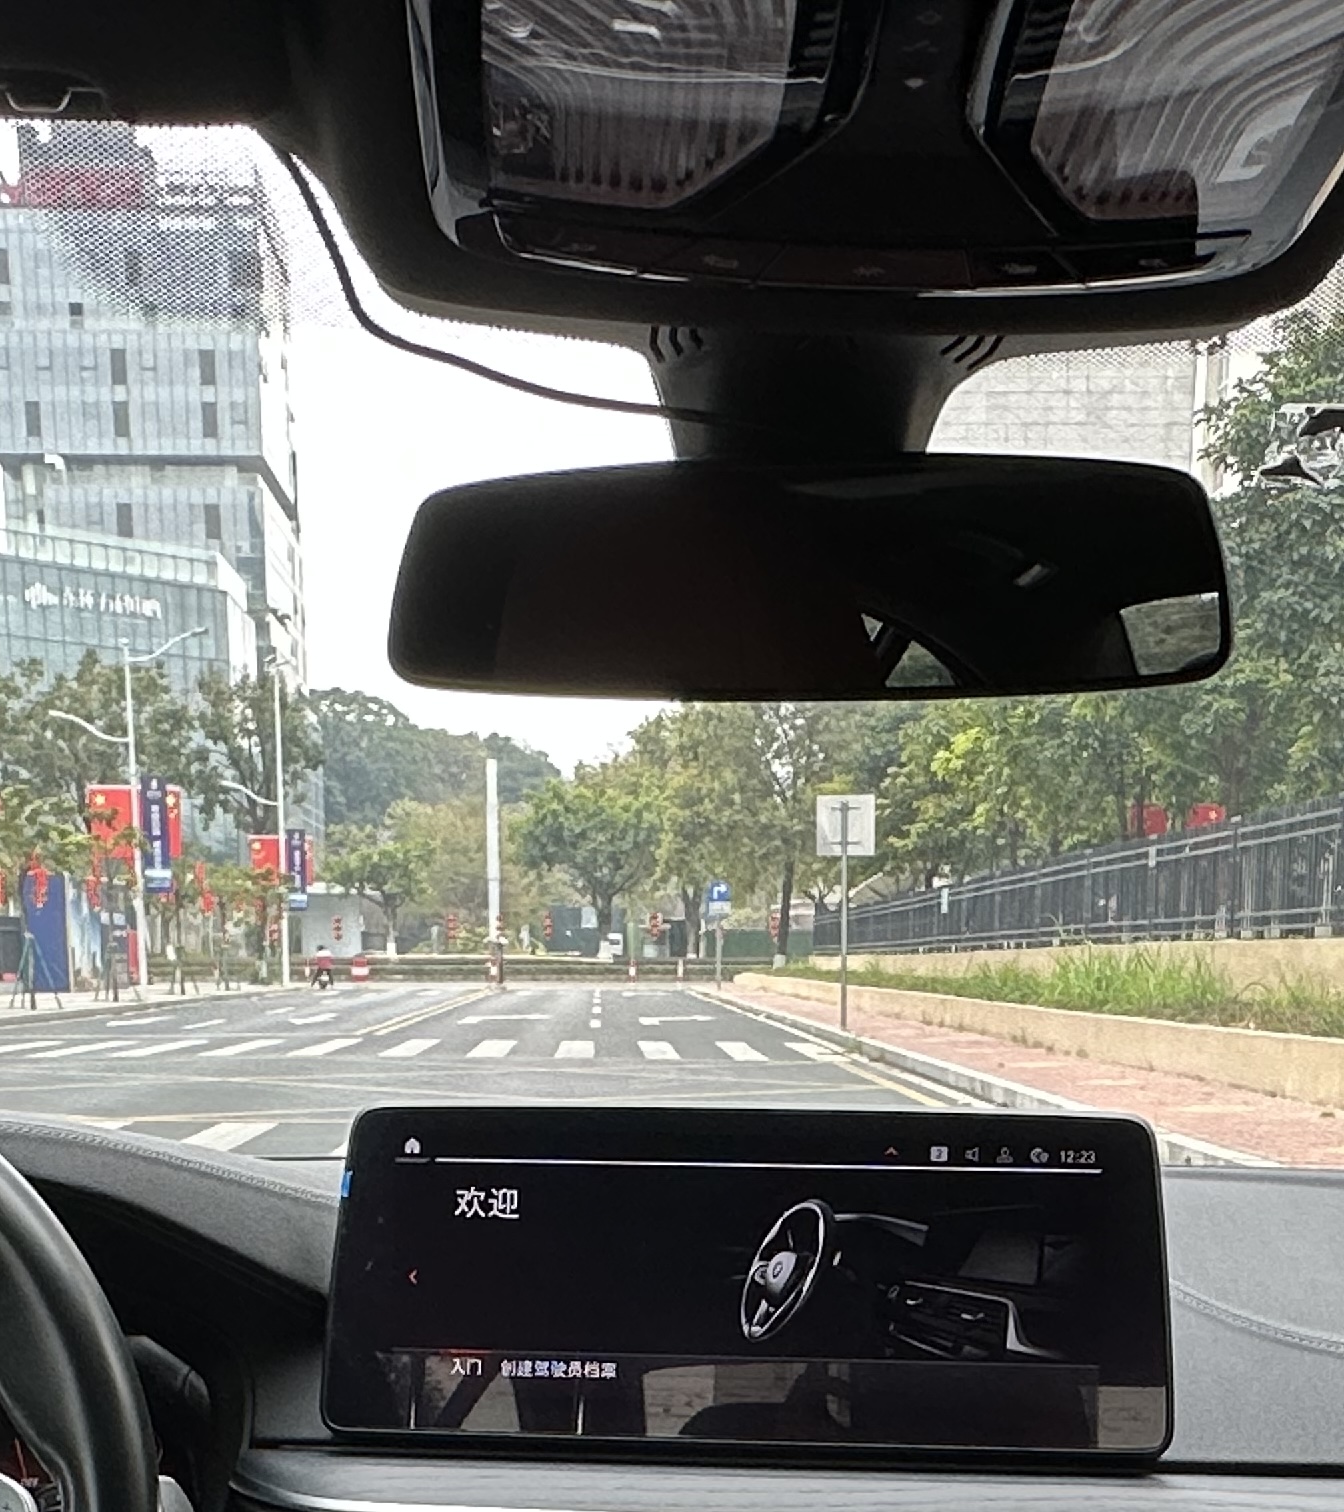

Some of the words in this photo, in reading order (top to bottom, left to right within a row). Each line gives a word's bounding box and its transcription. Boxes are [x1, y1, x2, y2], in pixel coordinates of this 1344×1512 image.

[1060, 1150, 1096, 1164] 12:23
[454, 1186, 520, 1219] 欢迎
[450, 1358, 483, 1376] 入门
[500, 1359, 618, 1380] 创建驾驶员档案
